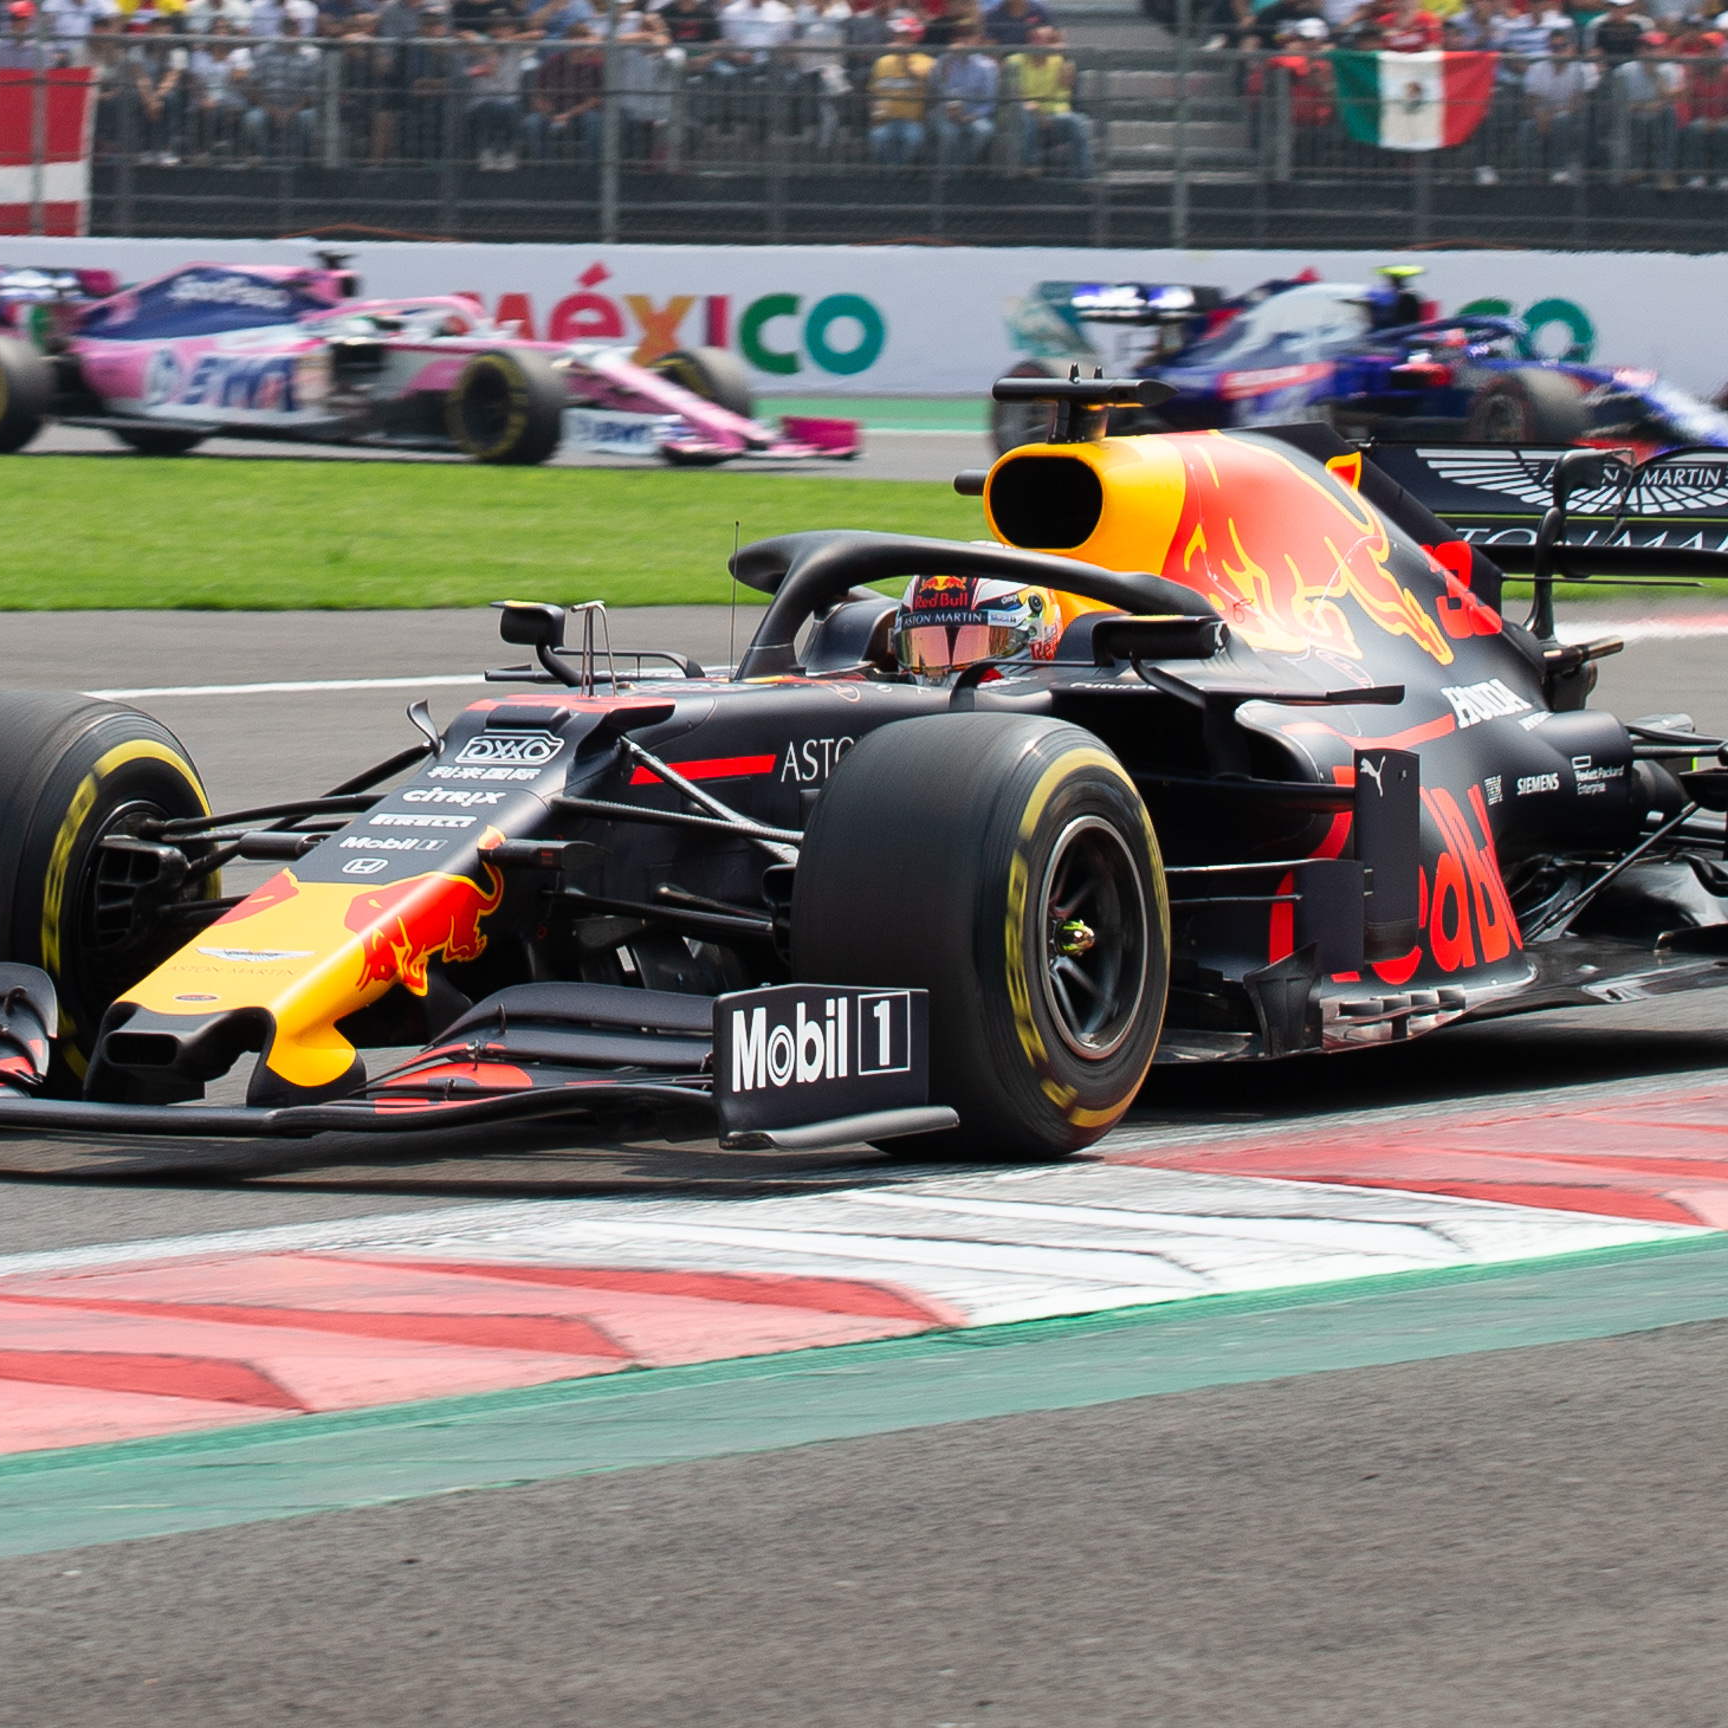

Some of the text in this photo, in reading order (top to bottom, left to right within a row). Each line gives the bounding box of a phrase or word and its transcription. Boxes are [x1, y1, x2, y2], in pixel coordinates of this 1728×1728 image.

[1640, 467, 1722, 486] MARTIN
[914, 592, 969, 610] Red Bull
[903, 611, 983, 626] ASTON MARTIN
[1440, 678, 1534, 729] HONDA
[1516, 772, 1561, 797] SIEMENS
[368, 813, 478, 828] PIRELLI
[339, 836, 420, 850] Mobil
[732, 996, 848, 1092] Mobil
